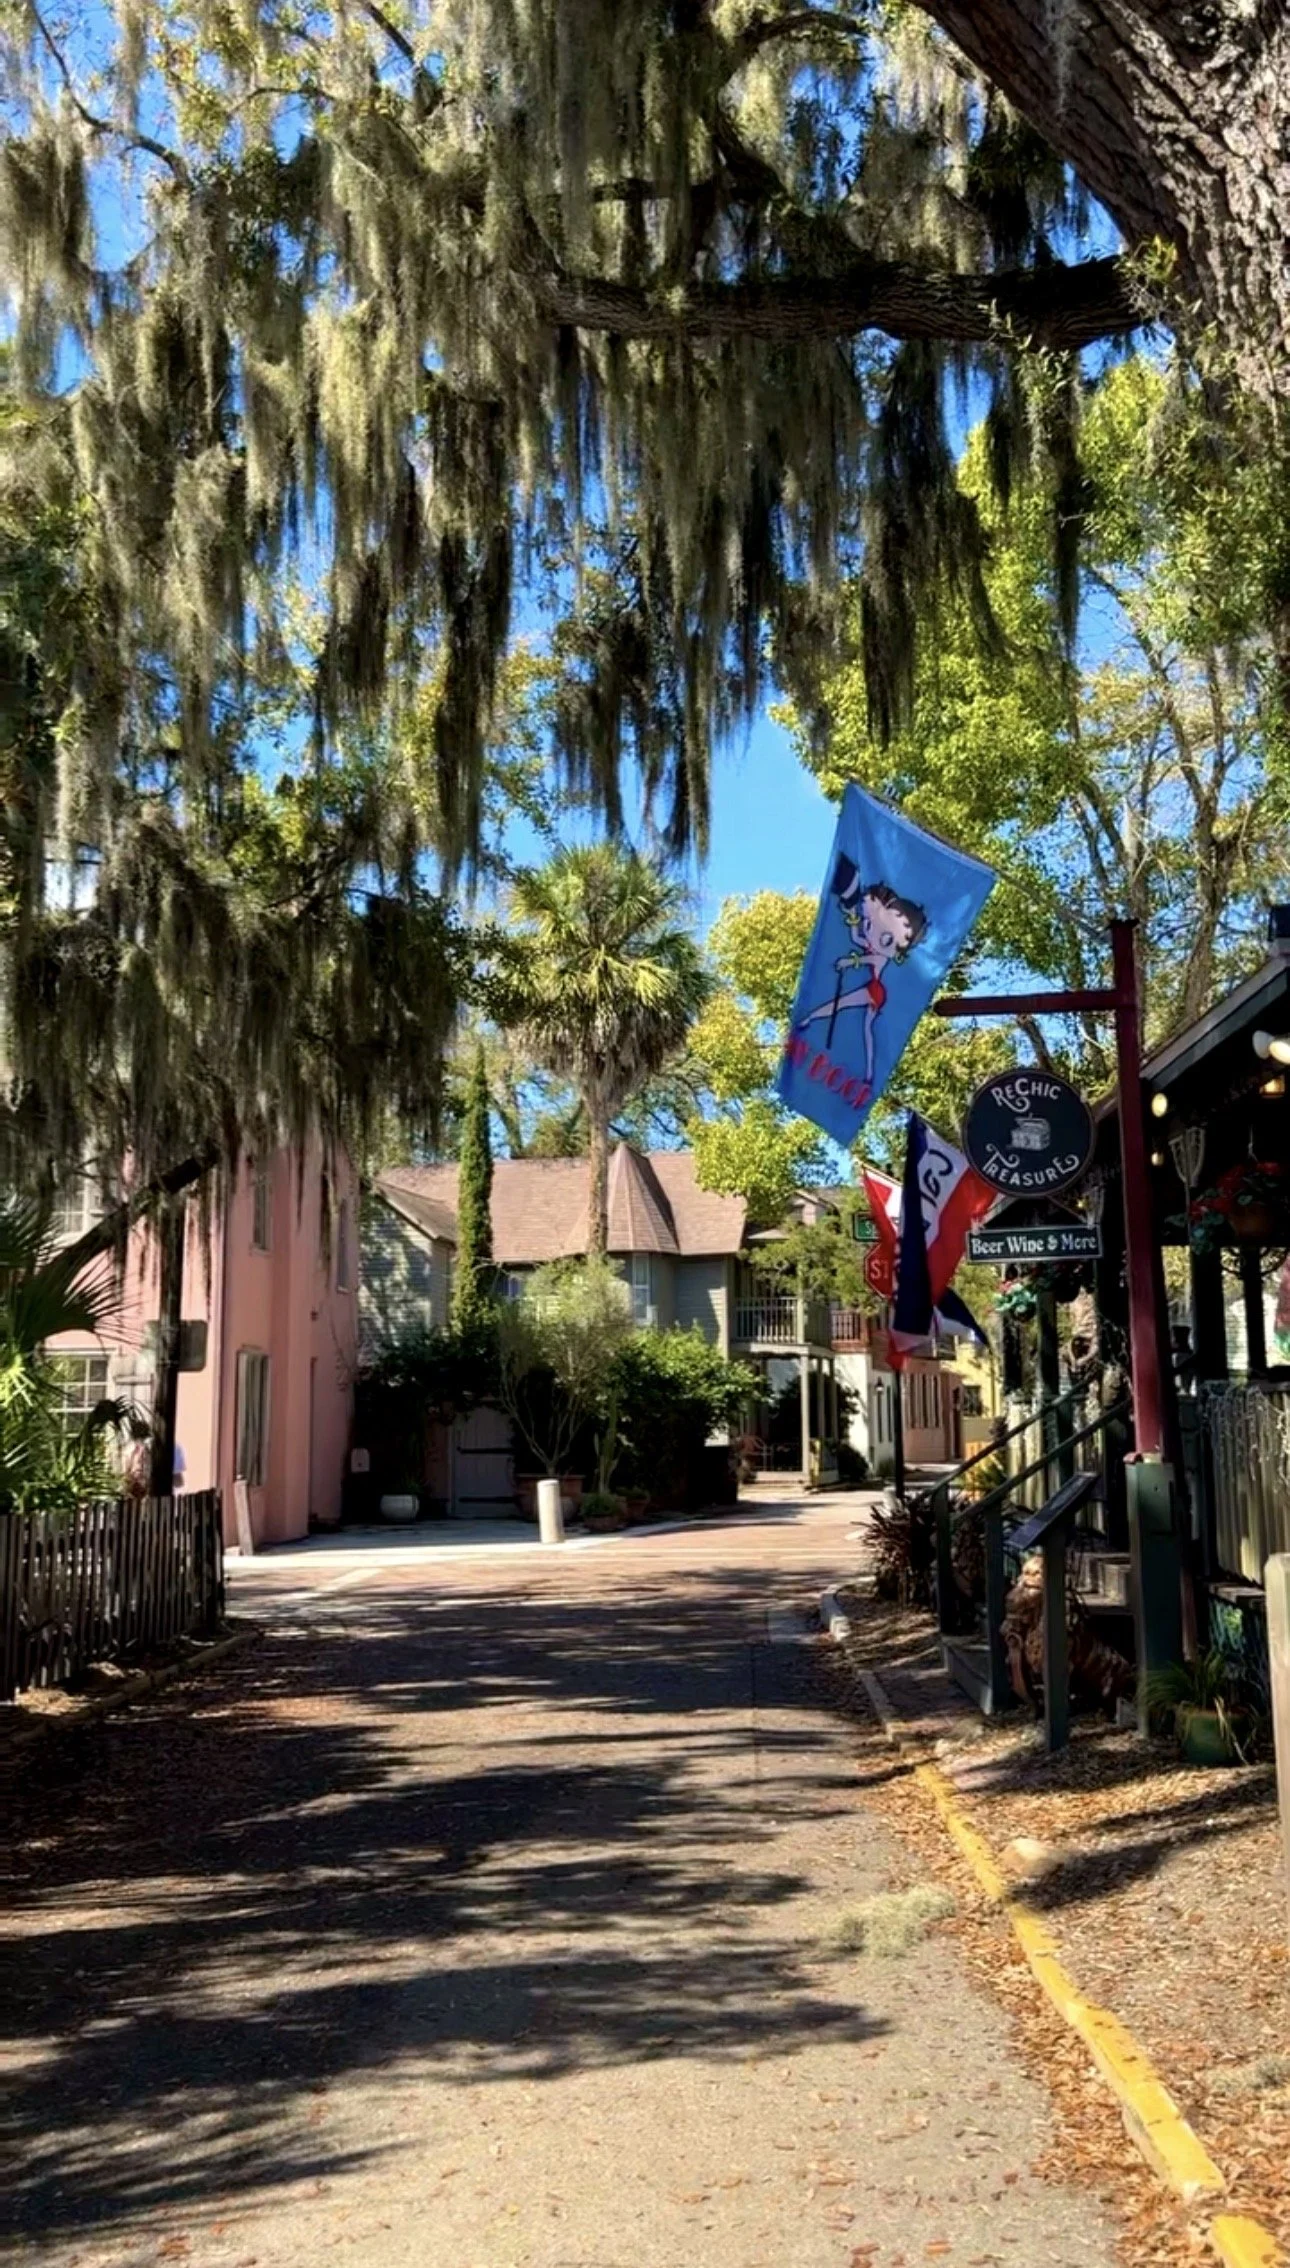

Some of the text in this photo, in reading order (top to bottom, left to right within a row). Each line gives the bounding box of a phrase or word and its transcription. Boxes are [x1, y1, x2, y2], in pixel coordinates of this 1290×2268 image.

[971, 1232, 1097, 1255] Beer Wine & More
[869, 1258, 890, 1280] ST
